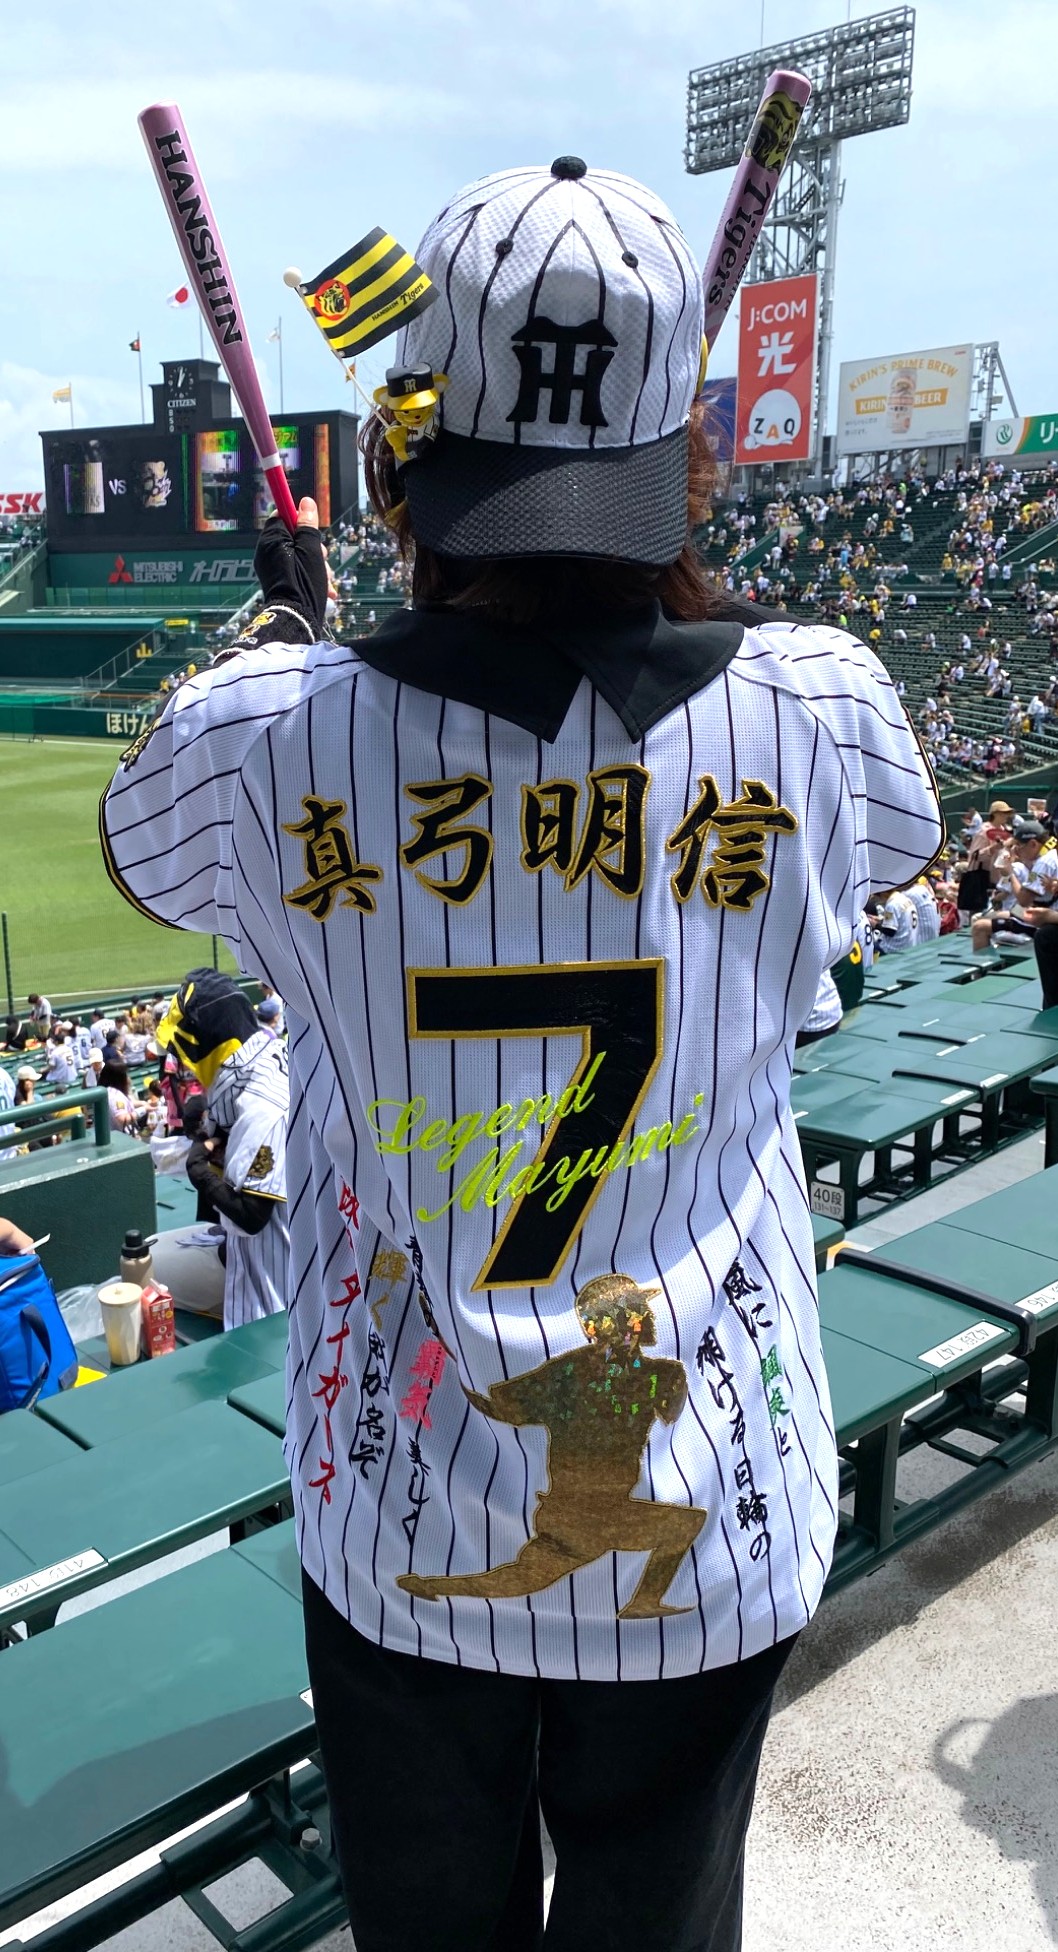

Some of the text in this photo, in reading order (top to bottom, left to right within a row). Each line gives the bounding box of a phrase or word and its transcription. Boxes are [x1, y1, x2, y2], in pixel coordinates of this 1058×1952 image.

[153, 129, 244, 346] HANSHIN
[709, 178, 771, 306] Tigers
[400, 282, 425, 306] Tigers
[747, 298, 808, 332] J:COM
[757, 331, 797, 378] 光
[848, 358, 959, 393] KIRIN'S PRIME BREW
[167, 398, 197, 408] CITIZEN
[754, 417, 796, 440] ZAQ
[108, 478, 127, 496] VS
[133, 561, 183, 573] MITSUBISHI
[134, 572, 178, 583] ELECTRIC
[281, 763, 799, 922] 真弓明信
[66, 1055, 73, 1066] 5
[367, 1051, 607, 1172] Legend
[406, 957, 666, 1293] 7
[416, 1092, 705, 1222] Mayumi
[814, 1187, 842, 1206] 40段
